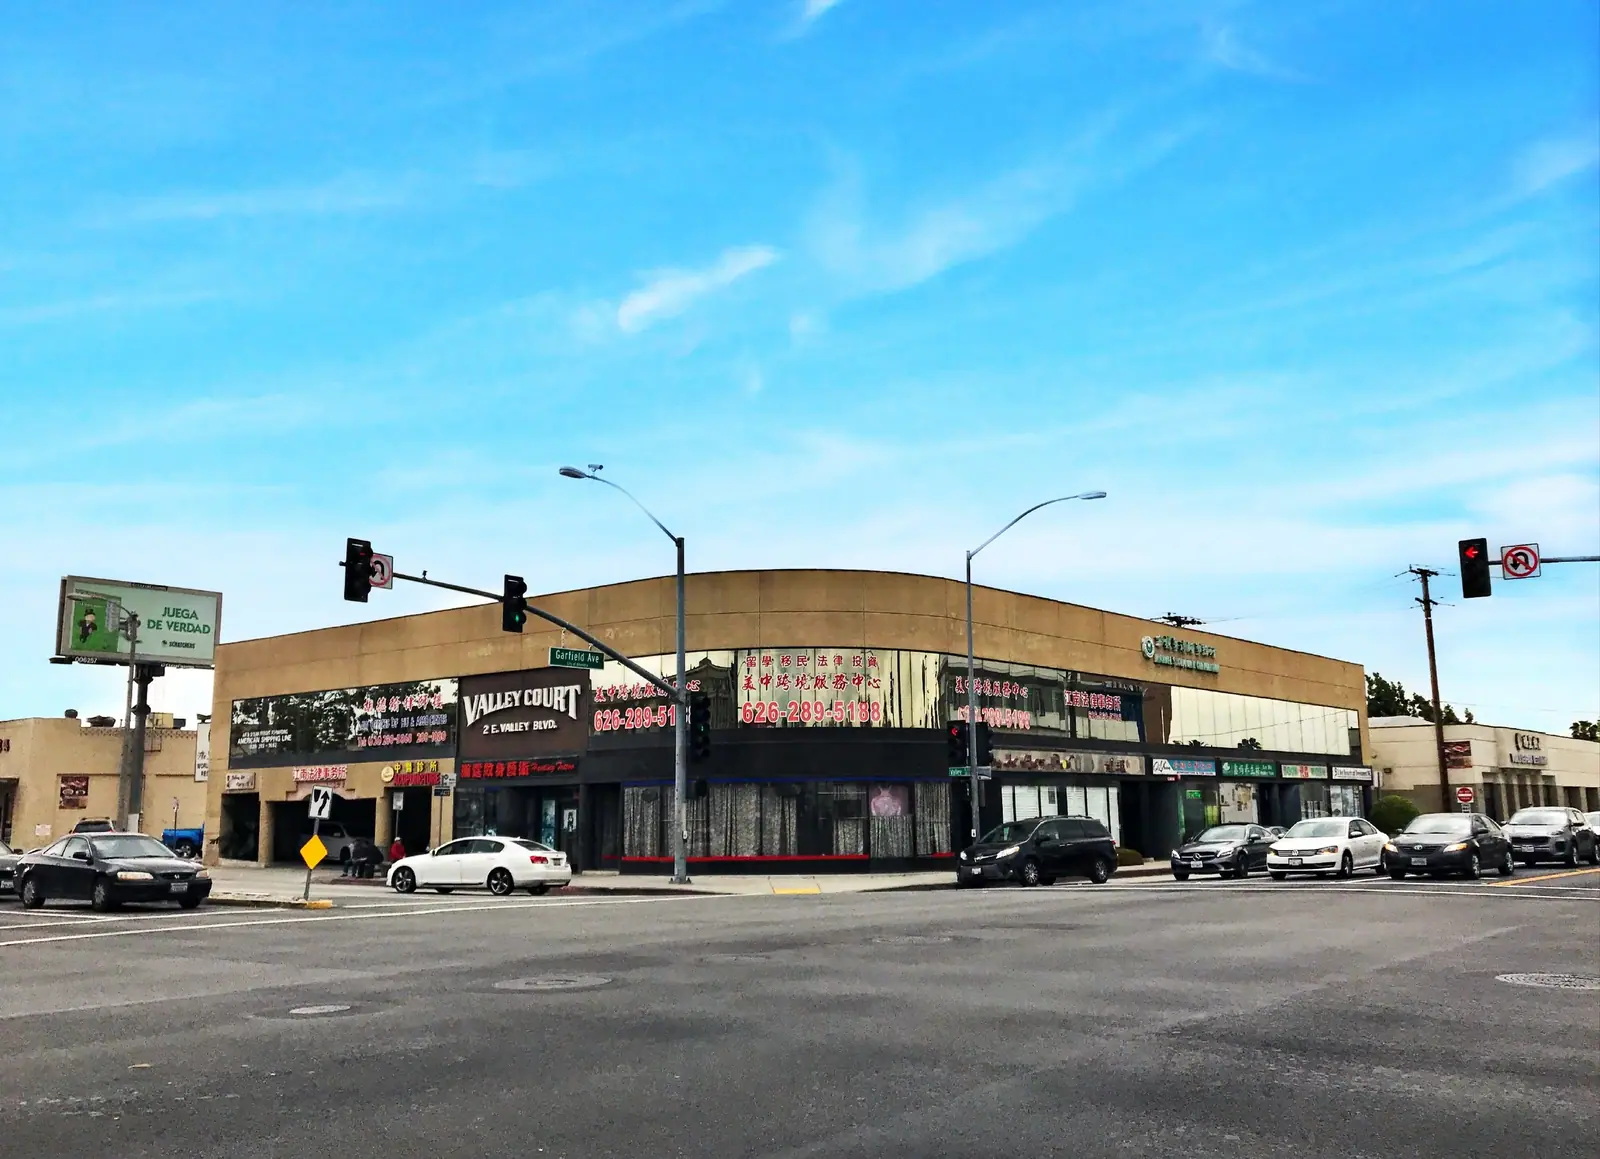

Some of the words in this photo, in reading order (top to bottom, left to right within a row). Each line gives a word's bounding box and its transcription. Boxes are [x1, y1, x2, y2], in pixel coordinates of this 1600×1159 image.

[162, 606, 199, 620] JUEGA
[147, 619, 163, 630] DE
[166, 621, 211, 634] VERDAD
[555, 649, 585, 662] Garfield
[587, 653, 600, 664] Ave
[742, 673, 882, 691] 美中跨境服務中心
[463, 690, 523, 727] VALLEY
[523, 684, 581, 720] COURT
[742, 700, 881, 723] 626-289-5188
[594, 704, 691, 731] 626-289-51
[482, 725, 490, 735] 2
[491, 724, 499, 734] E.
[499, 721, 530, 733] VALLEY
[532, 719, 558, 730] BLVD.
[237, 736, 260, 745] AMERICAN
[261, 735, 281, 743] SHIPPING
[281, 734, 292, 742] LINE
